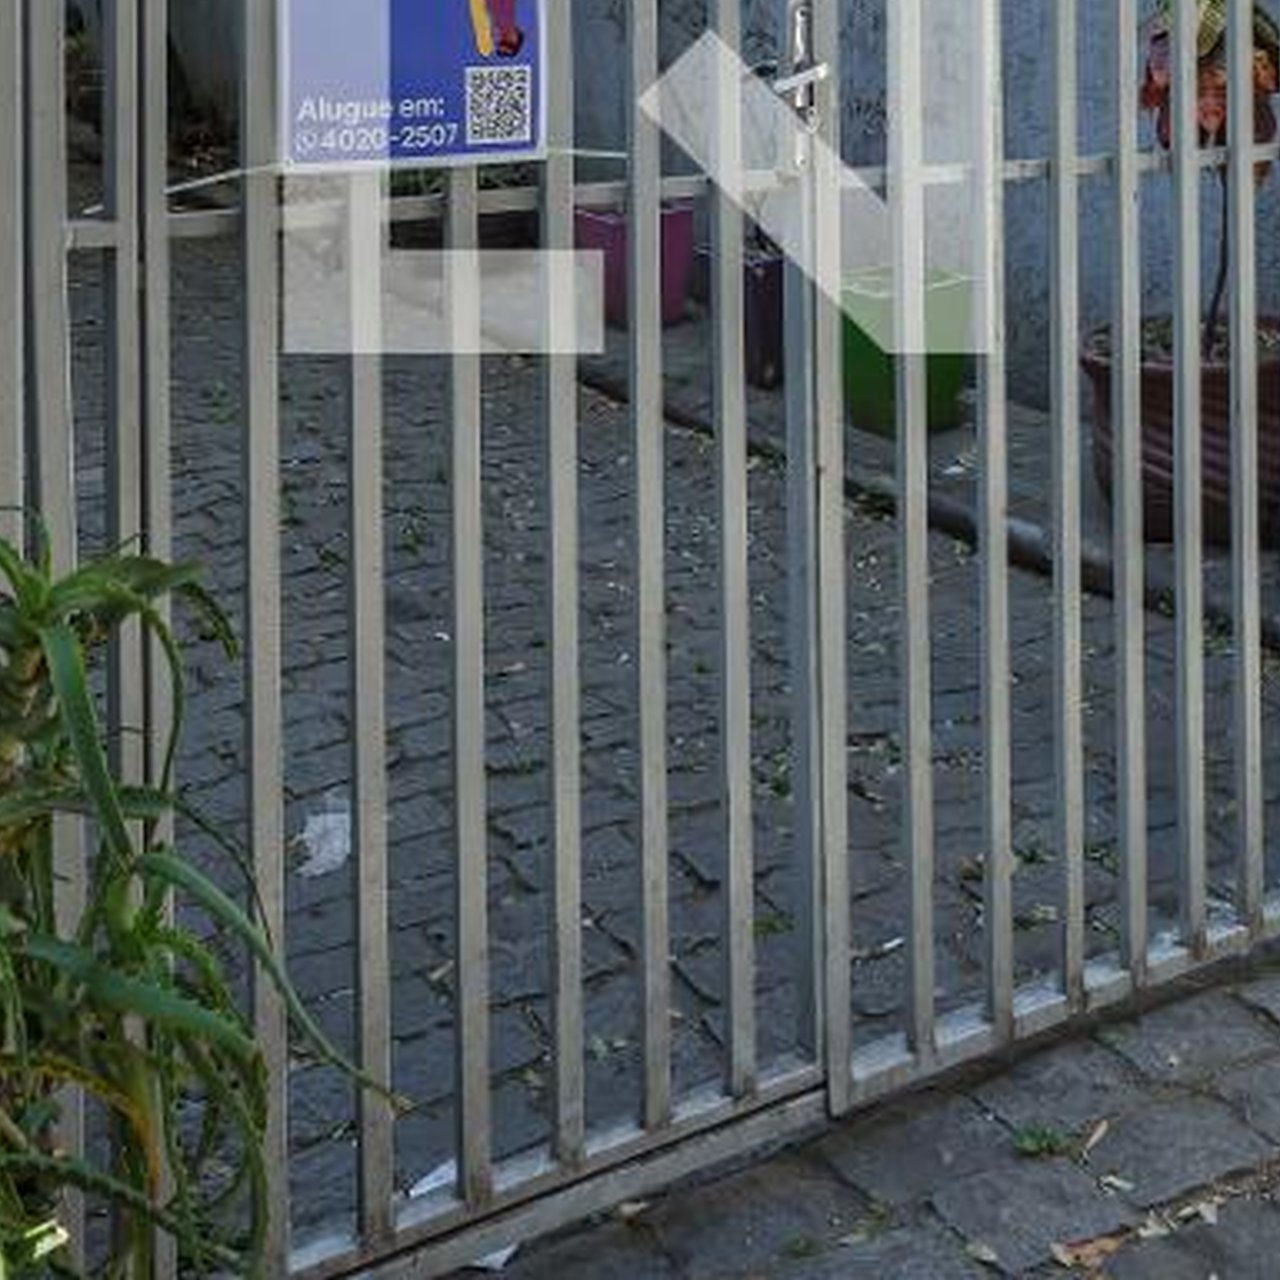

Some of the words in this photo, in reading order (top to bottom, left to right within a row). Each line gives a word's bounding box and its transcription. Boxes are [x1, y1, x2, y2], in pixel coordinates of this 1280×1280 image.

[296, 95, 391, 125] Alugue
[398, 97, 446, 119] em:
[320, 121, 460, 151] 4020-2507
